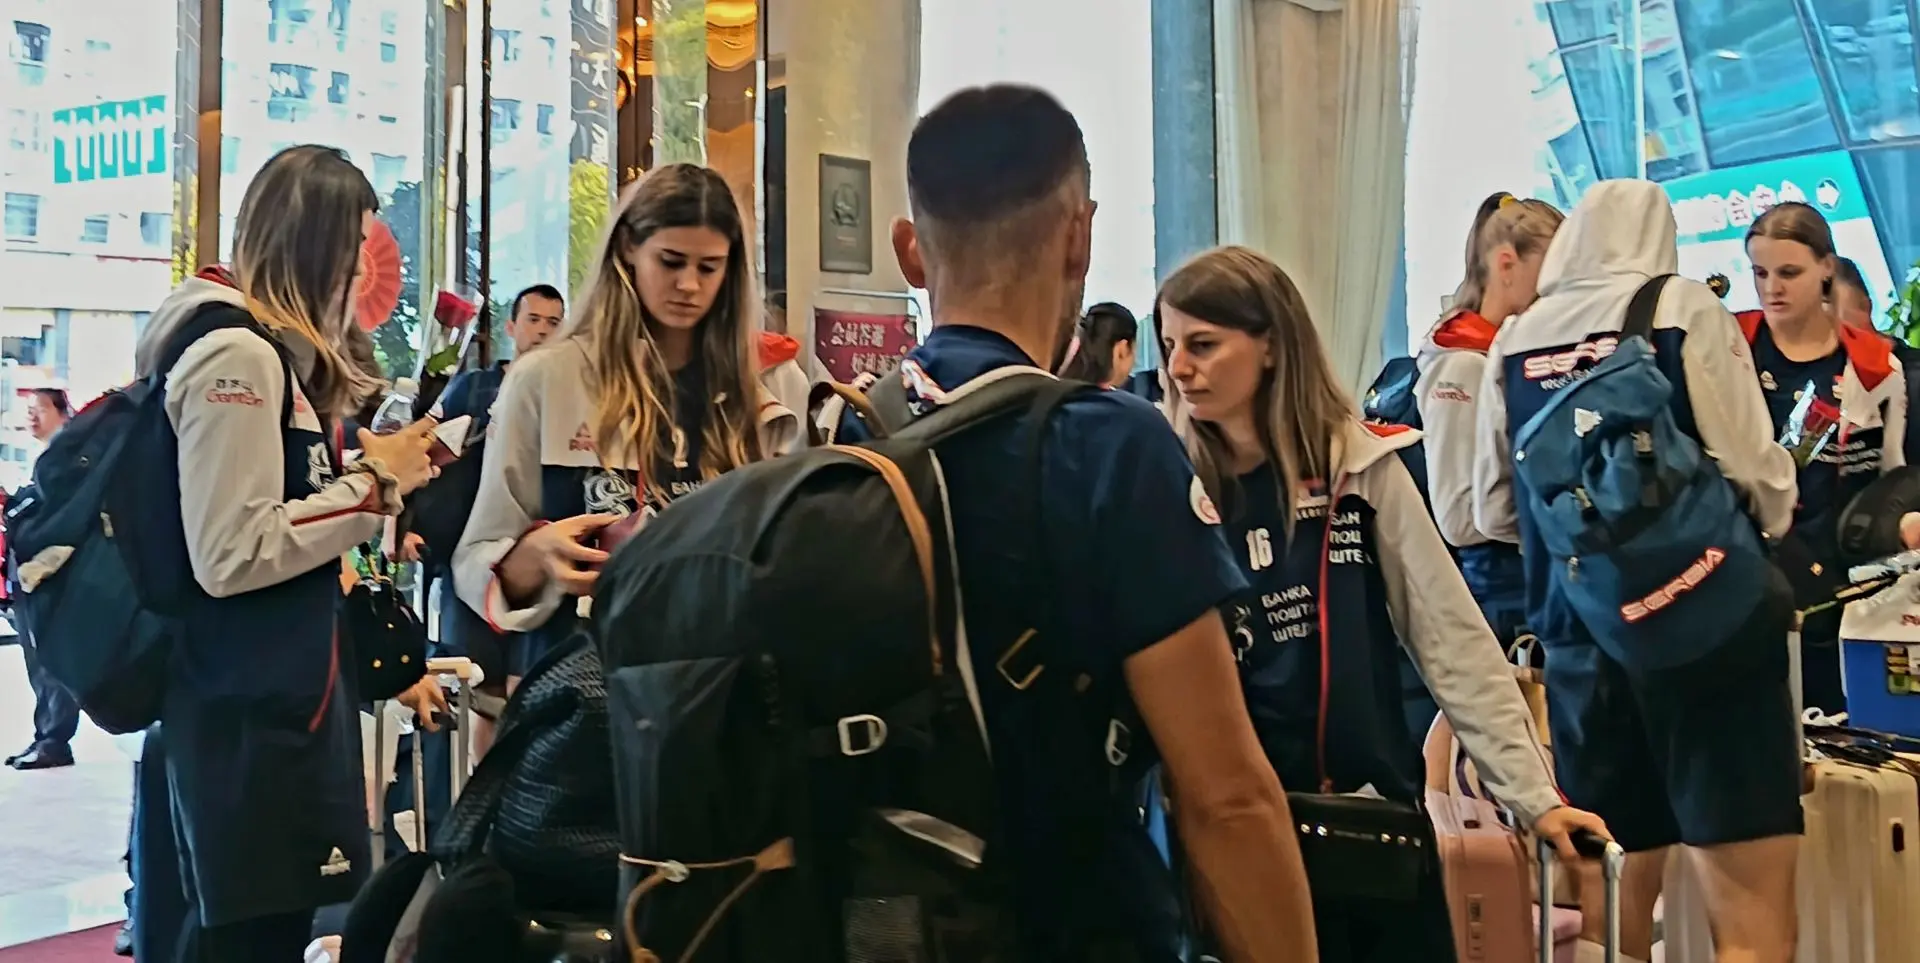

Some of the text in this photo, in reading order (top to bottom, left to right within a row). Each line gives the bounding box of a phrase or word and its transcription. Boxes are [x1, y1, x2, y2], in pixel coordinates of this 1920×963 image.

[1246, 527, 1274, 571] 16
[1328, 548, 1374, 565] ШТЕ
[1621, 547, 1726, 623] SERBIA
